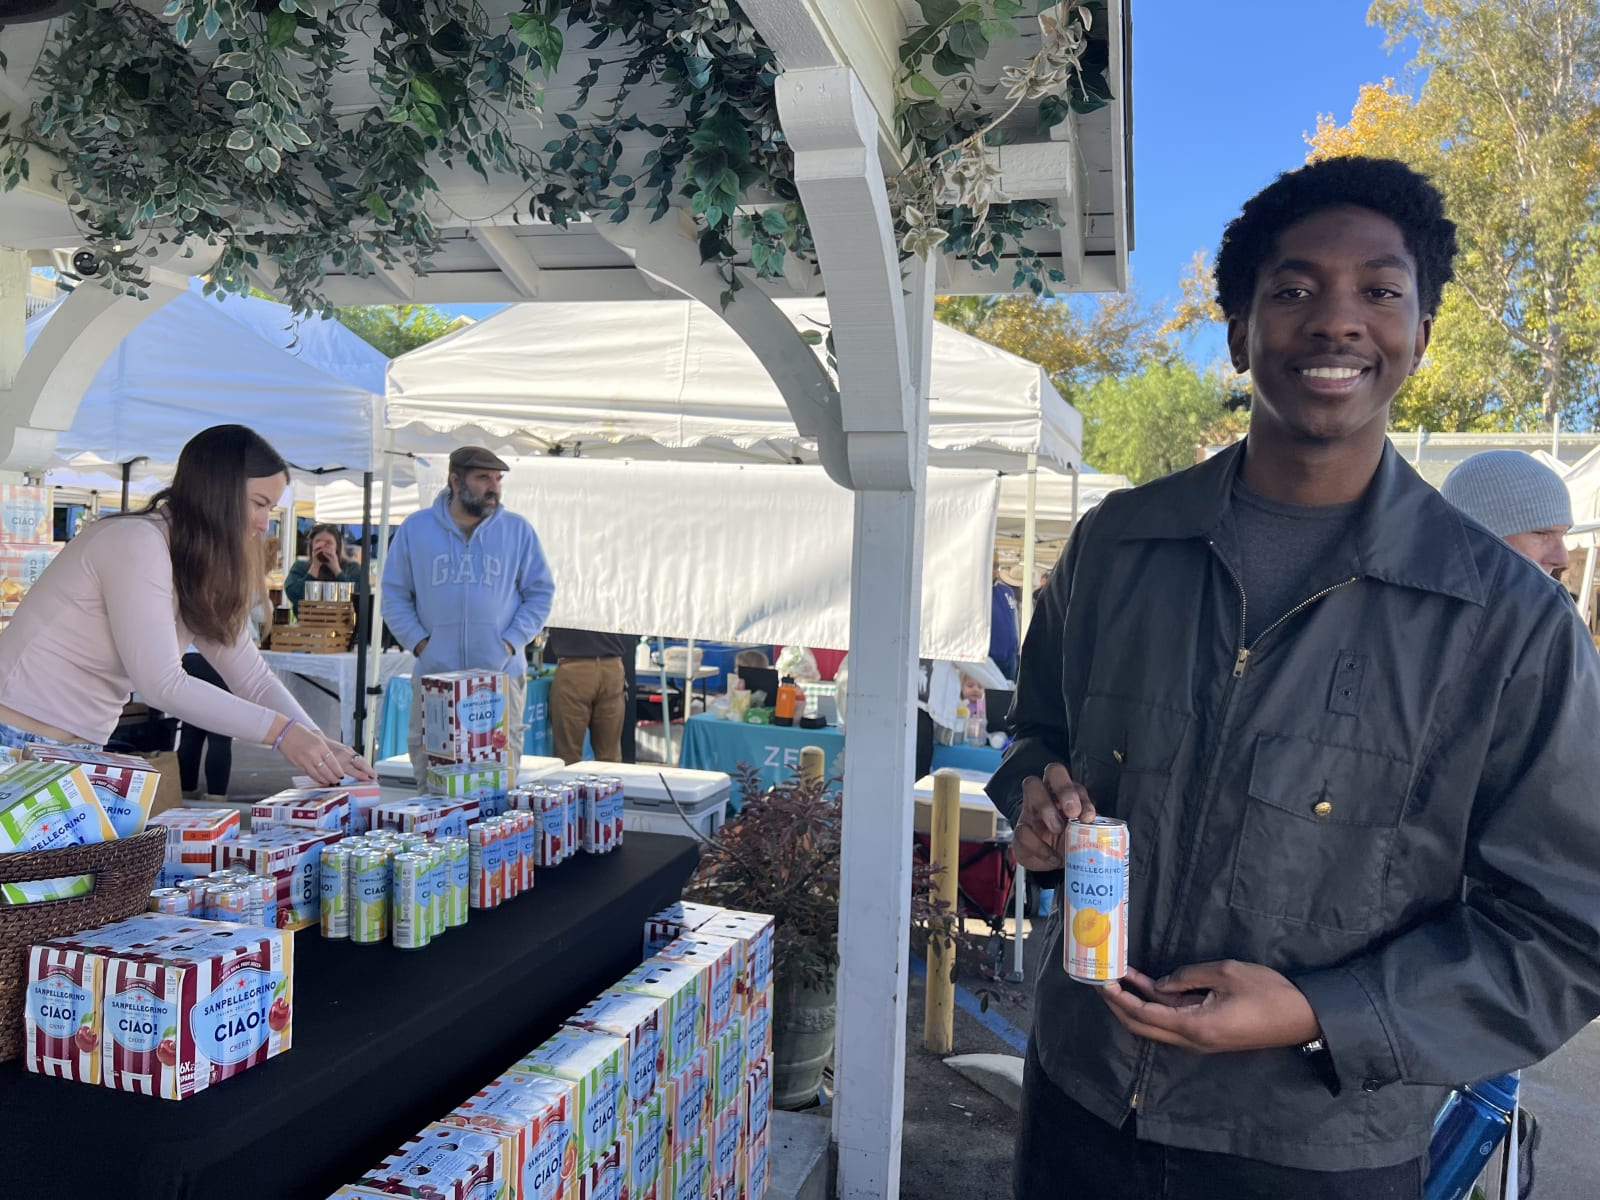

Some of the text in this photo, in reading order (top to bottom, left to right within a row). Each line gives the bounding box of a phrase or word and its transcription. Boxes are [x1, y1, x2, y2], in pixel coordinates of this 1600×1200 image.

[431, 553, 501, 587] GAP
[1070, 881, 1113, 897] CIAO!
[1080, 897, 1102, 906] PEACH
[35, 987, 86, 1001] SANPELLEGRINO
[204, 981, 277, 1016] SANPELLEGRINO
[40, 1005, 76, 1022] CIAO!
[112, 1001, 168, 1015] SANPELLEGRINO
[119, 1019, 158, 1035] CIAO!
[214, 1007, 266, 1042] CIAO!
[229, 1038, 253, 1053] CHERRY
[534, 1152, 563, 1190] CIAO!
